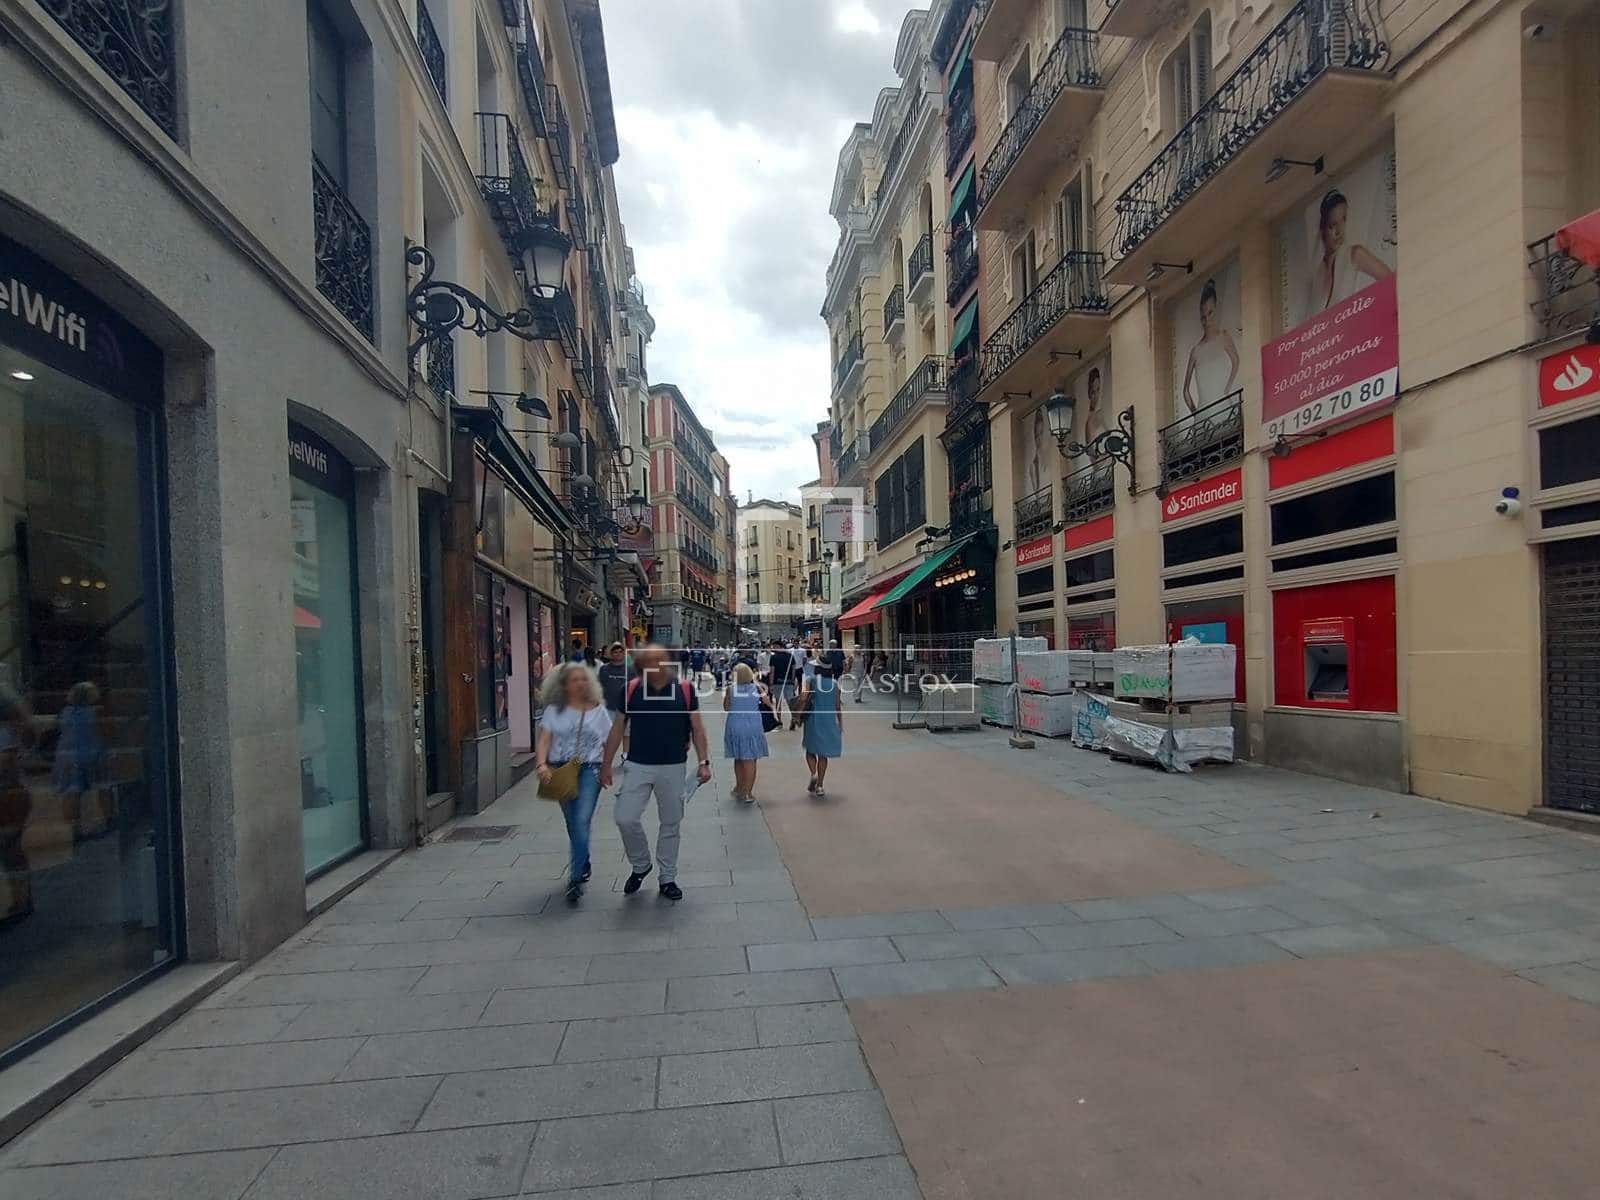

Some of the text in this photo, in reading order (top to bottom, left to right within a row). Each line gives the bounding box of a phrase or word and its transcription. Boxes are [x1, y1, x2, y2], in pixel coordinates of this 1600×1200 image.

[1278, 295, 1375, 356] Por esta calle
[1273, 335, 1384, 395] 50.000 personas
[1300, 332, 1345, 365] pasan
[1299, 383, 1315, 400] al
[1268, 377, 1385, 440] 91 192 70 80
[1180, 482, 1238, 511] Santander
[1025, 543, 1052, 560] Santander
